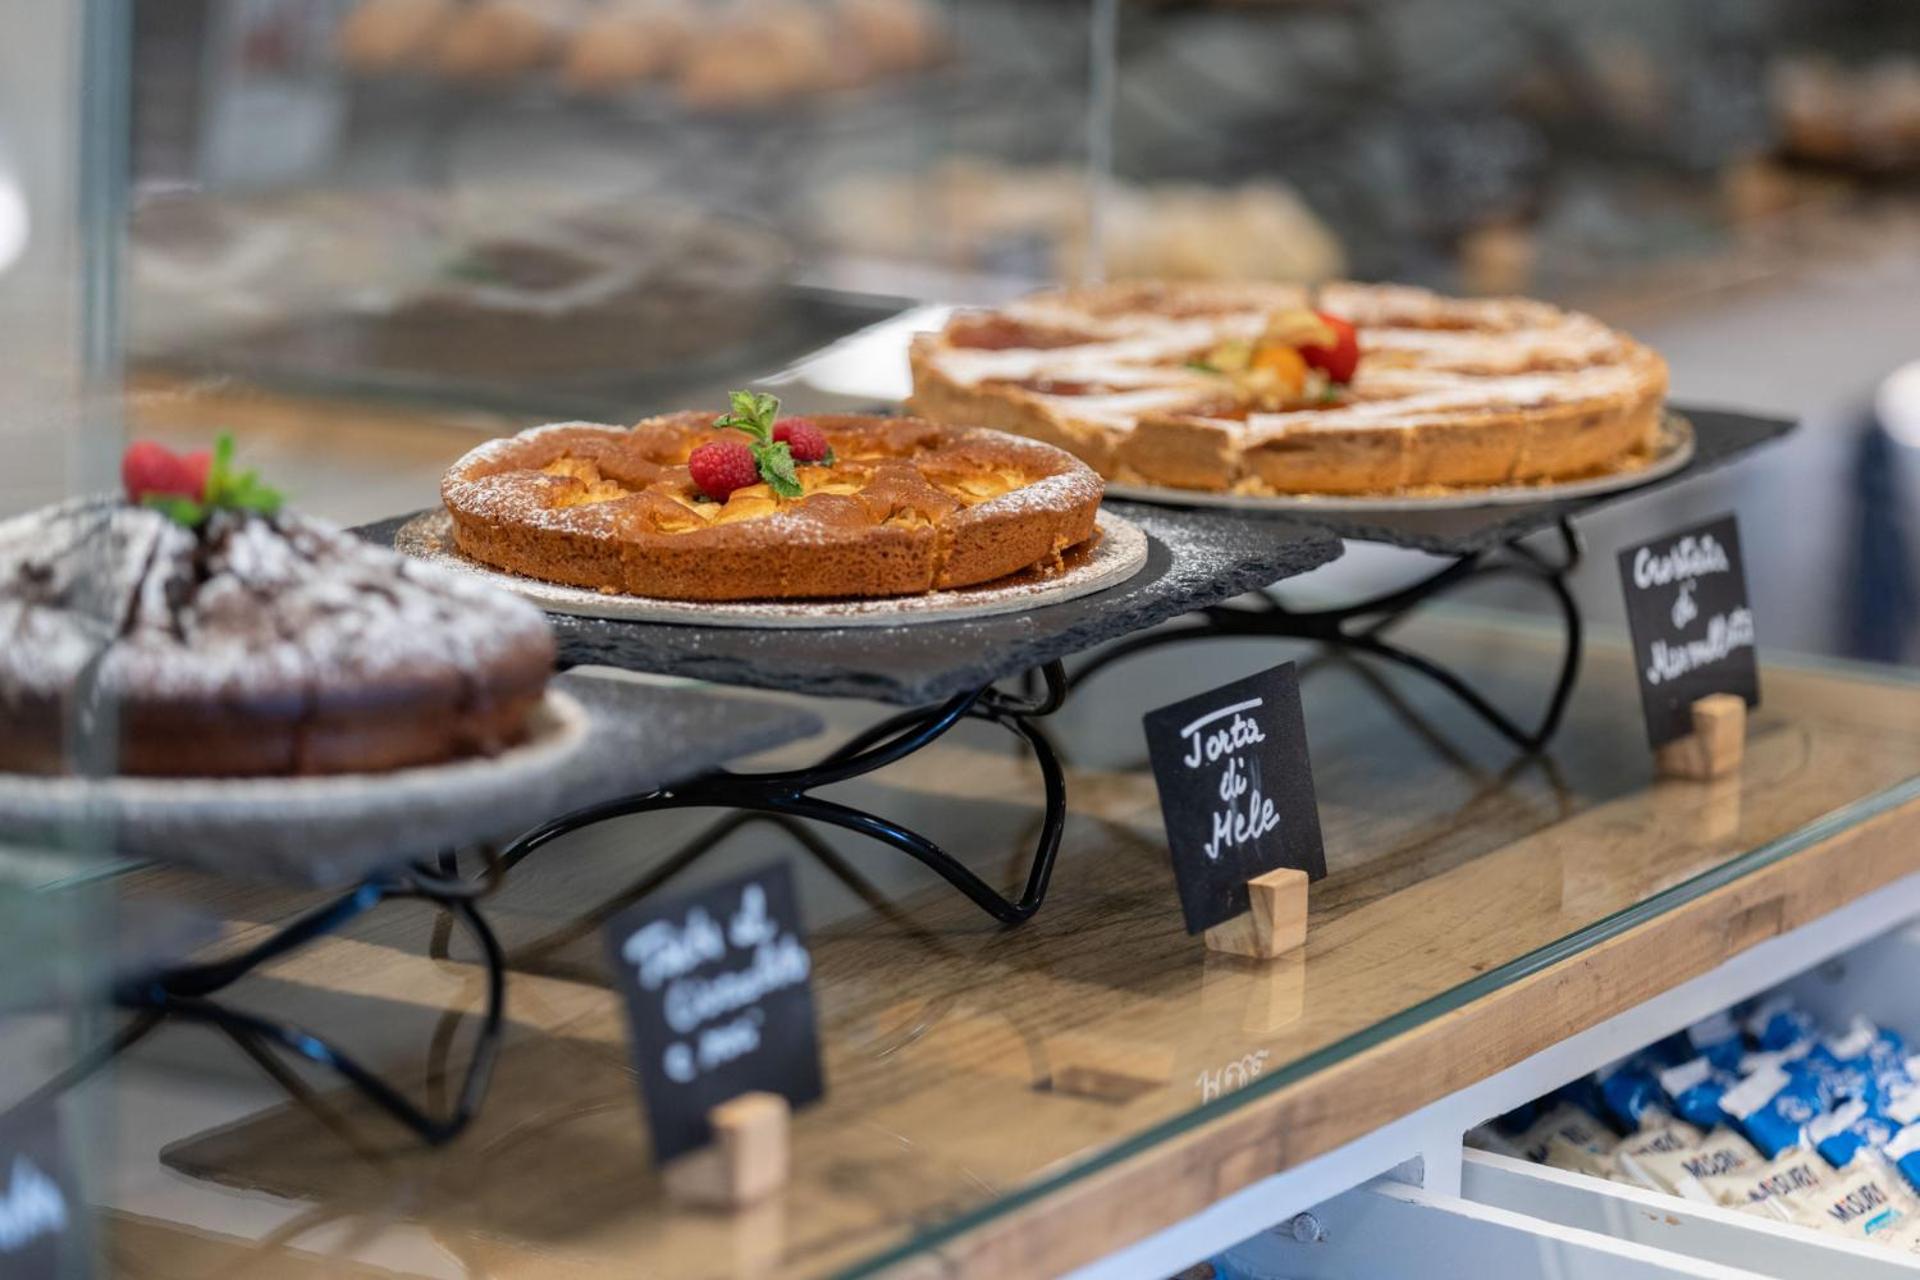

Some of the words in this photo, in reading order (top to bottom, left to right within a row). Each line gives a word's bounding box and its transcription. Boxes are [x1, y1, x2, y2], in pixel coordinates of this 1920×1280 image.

[1180, 697, 1266, 768] Torta
[1220, 757, 1247, 801] di
[1204, 789, 1280, 860] Mele
